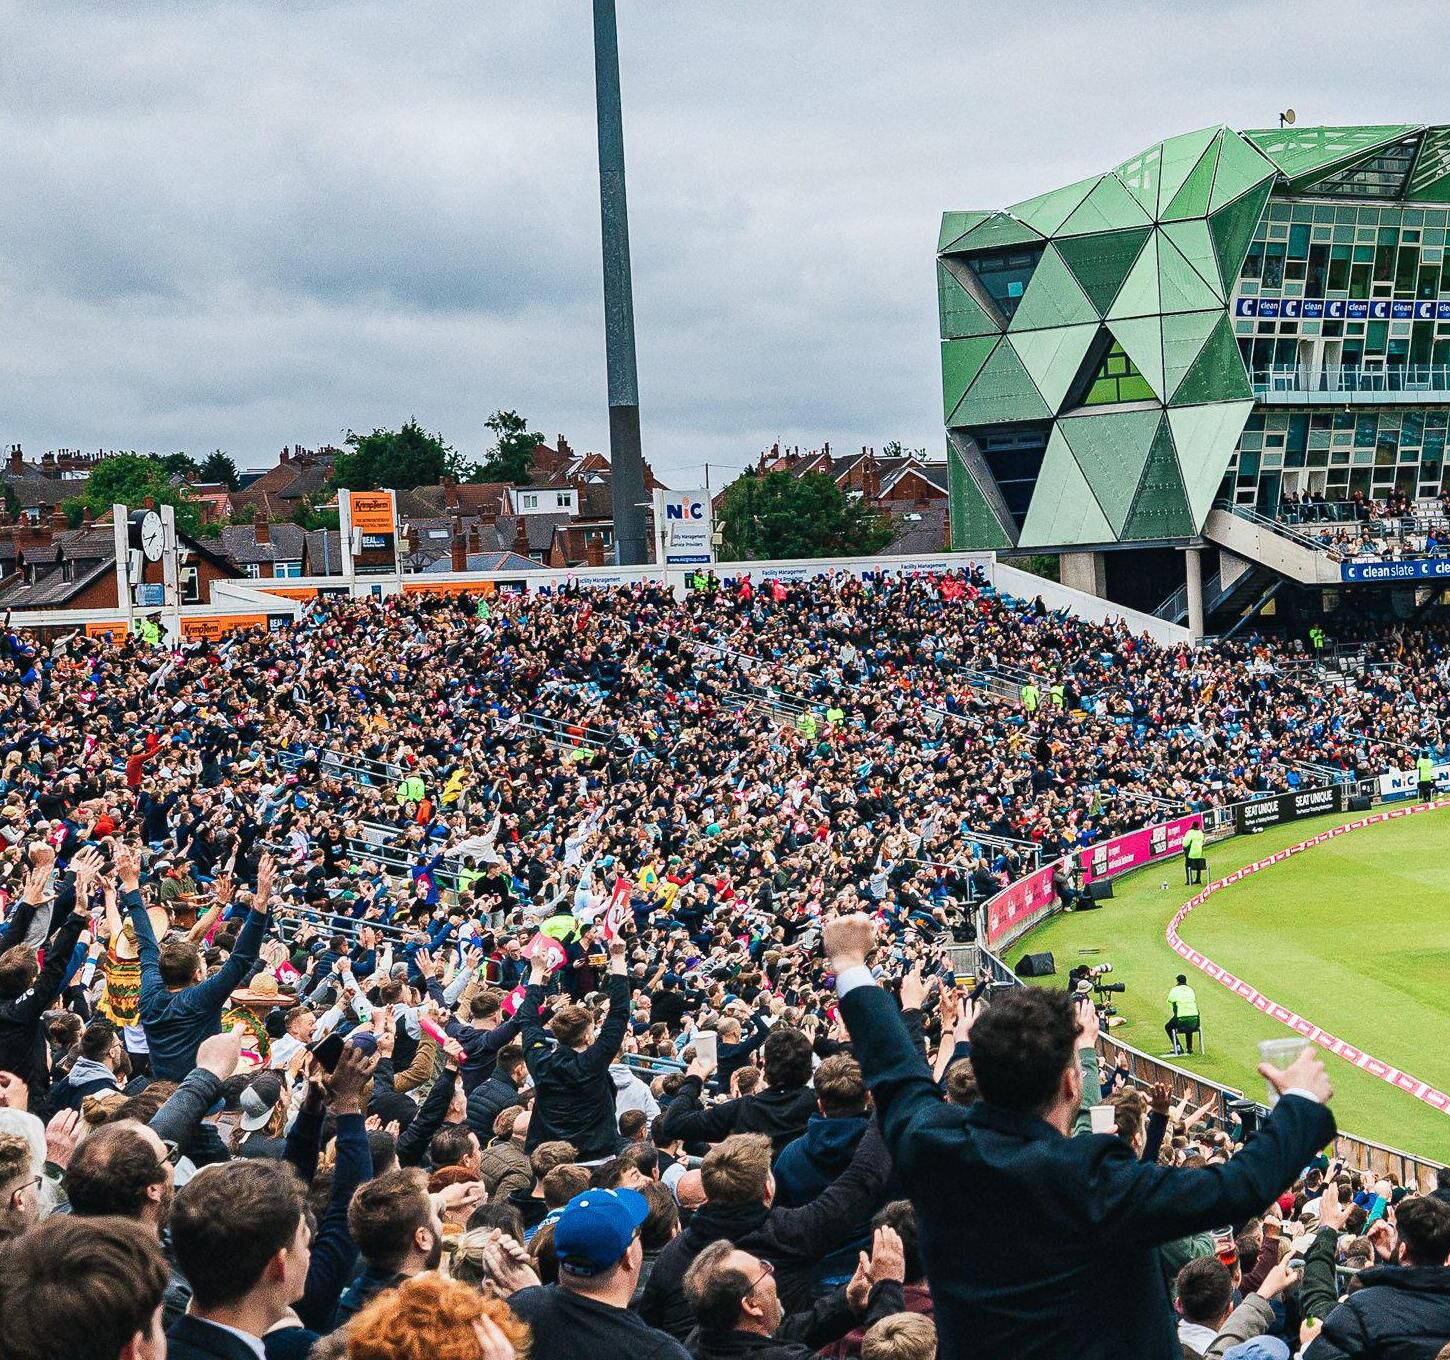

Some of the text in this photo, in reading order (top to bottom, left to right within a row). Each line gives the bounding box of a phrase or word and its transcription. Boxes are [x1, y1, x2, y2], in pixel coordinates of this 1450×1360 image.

[1394, 303, 1411, 311] clean
[1363, 566, 1389, 578] clean
[1391, 564, 1414, 577] slate
[1296, 790, 1333, 807] SEAT UNIQUE
[1245, 800, 1279, 818] SEAT UNIQUE
